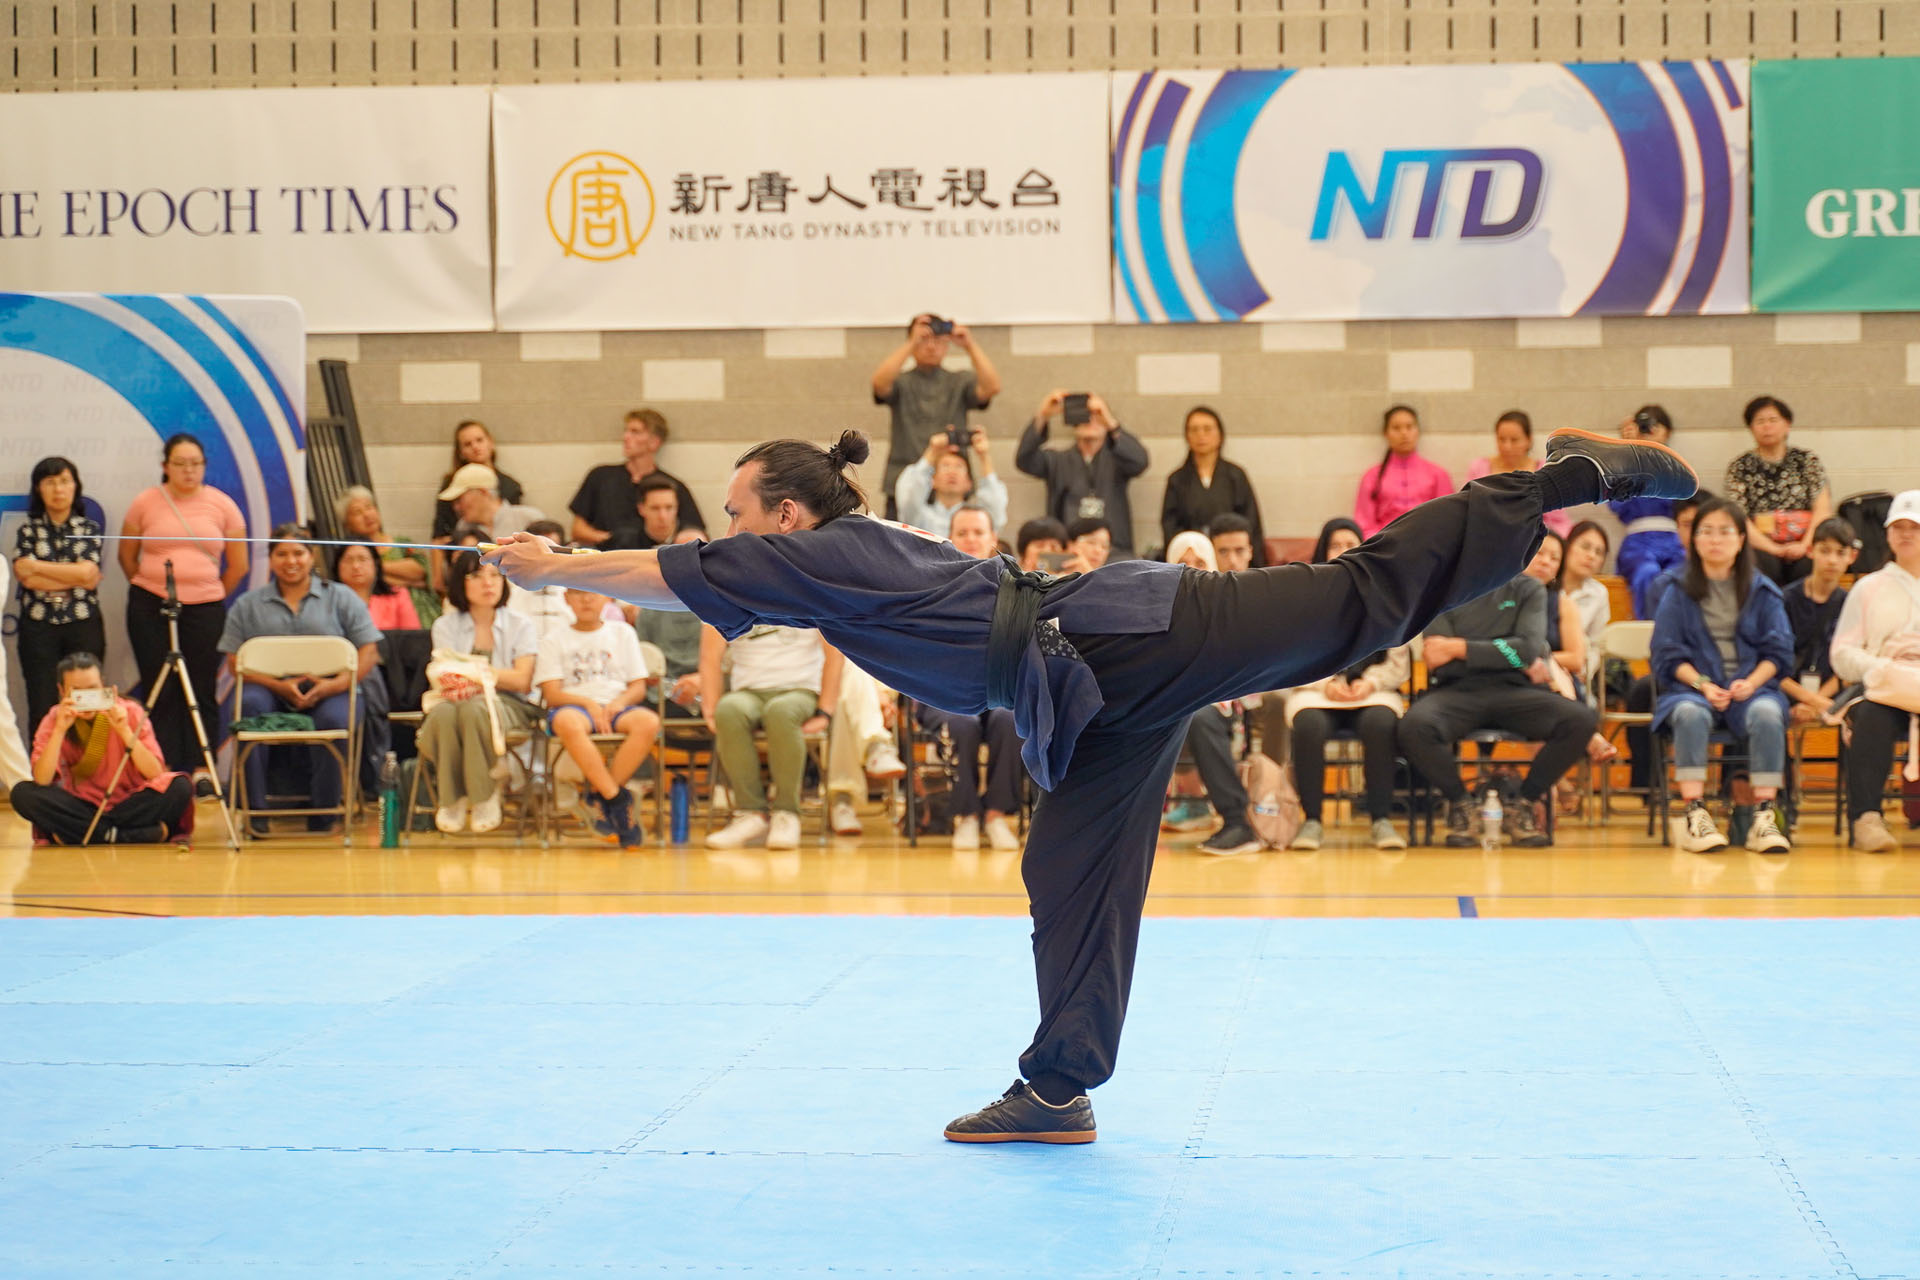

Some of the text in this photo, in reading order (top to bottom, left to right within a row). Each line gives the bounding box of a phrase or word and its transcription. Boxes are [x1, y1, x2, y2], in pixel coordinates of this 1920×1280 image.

[60, 186, 262, 238] EPOCH
[279, 184, 459, 234] TIMES
[1309, 148, 1544, 240] NTD
[669, 217, 1061, 242] NEW TANG DYNASTY TELEVISION
